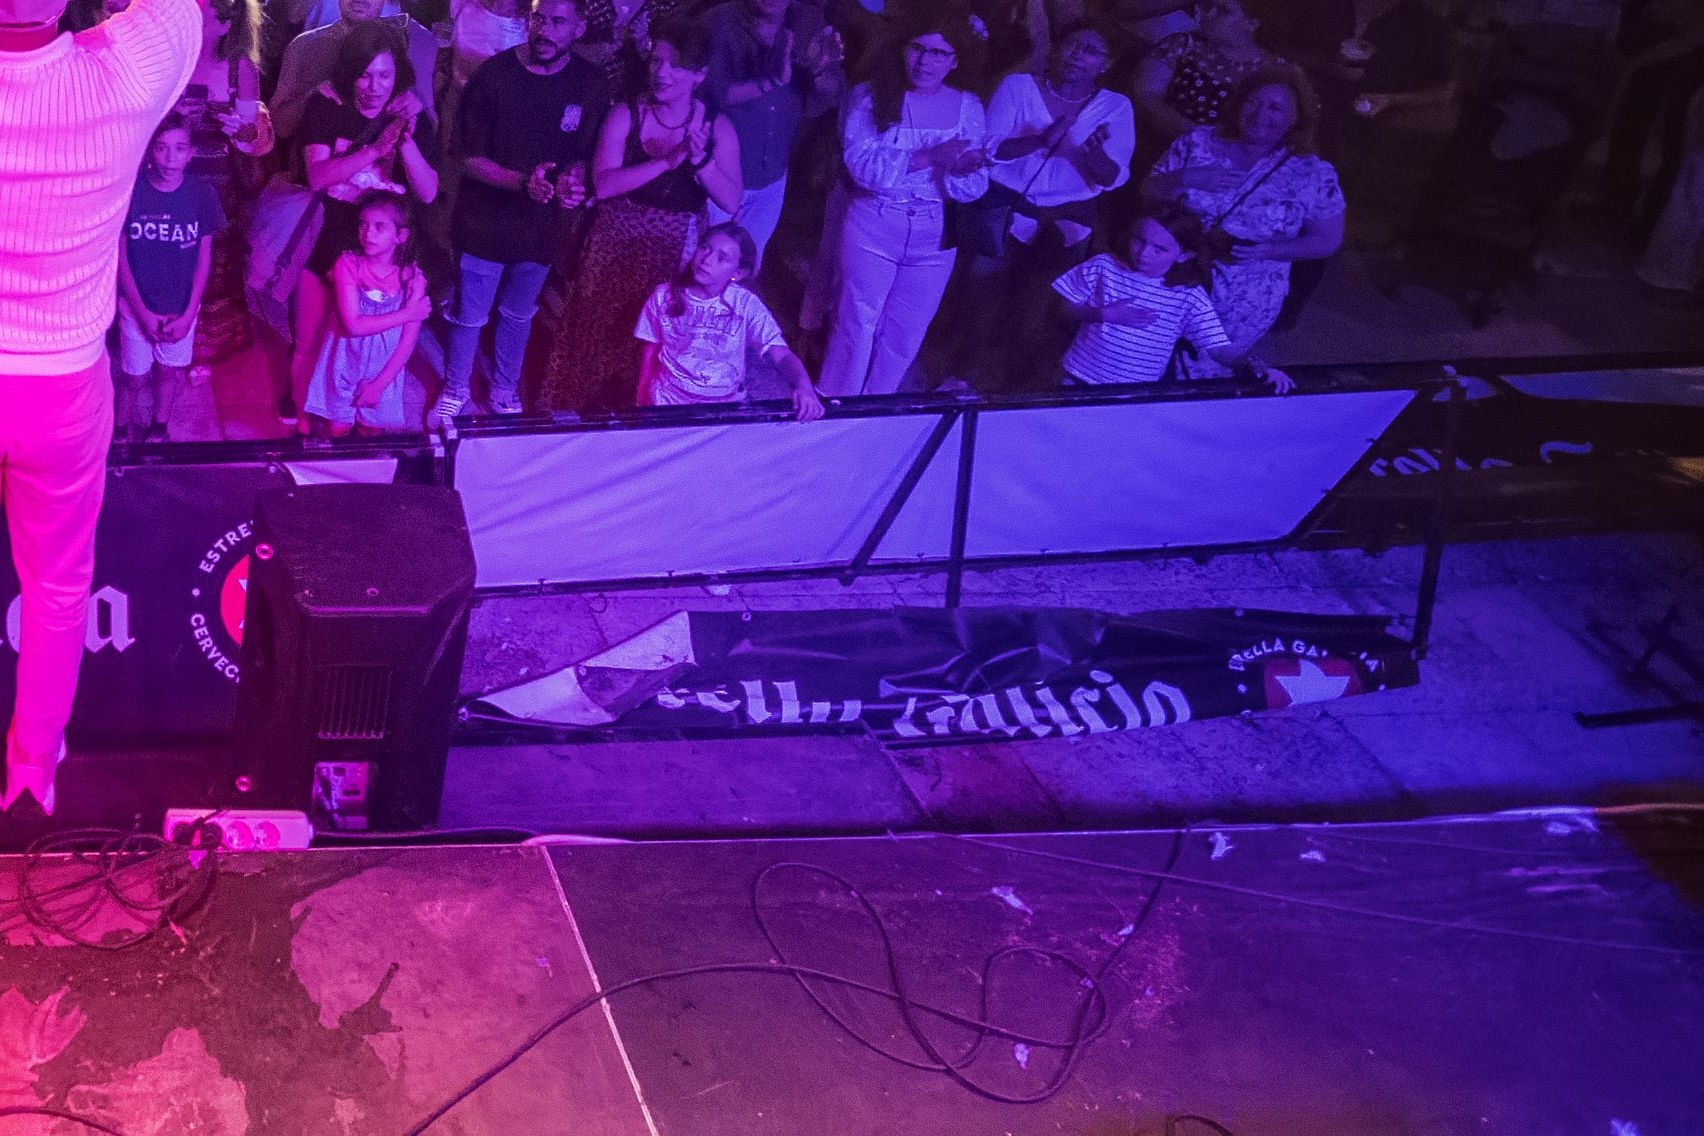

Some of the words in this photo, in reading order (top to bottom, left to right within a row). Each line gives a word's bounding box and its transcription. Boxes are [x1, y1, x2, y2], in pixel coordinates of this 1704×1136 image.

[129, 220, 199, 242] OCEAN
[198, 520, 254, 574] ESTRE
[190, 613, 241, 684] CERVEC
